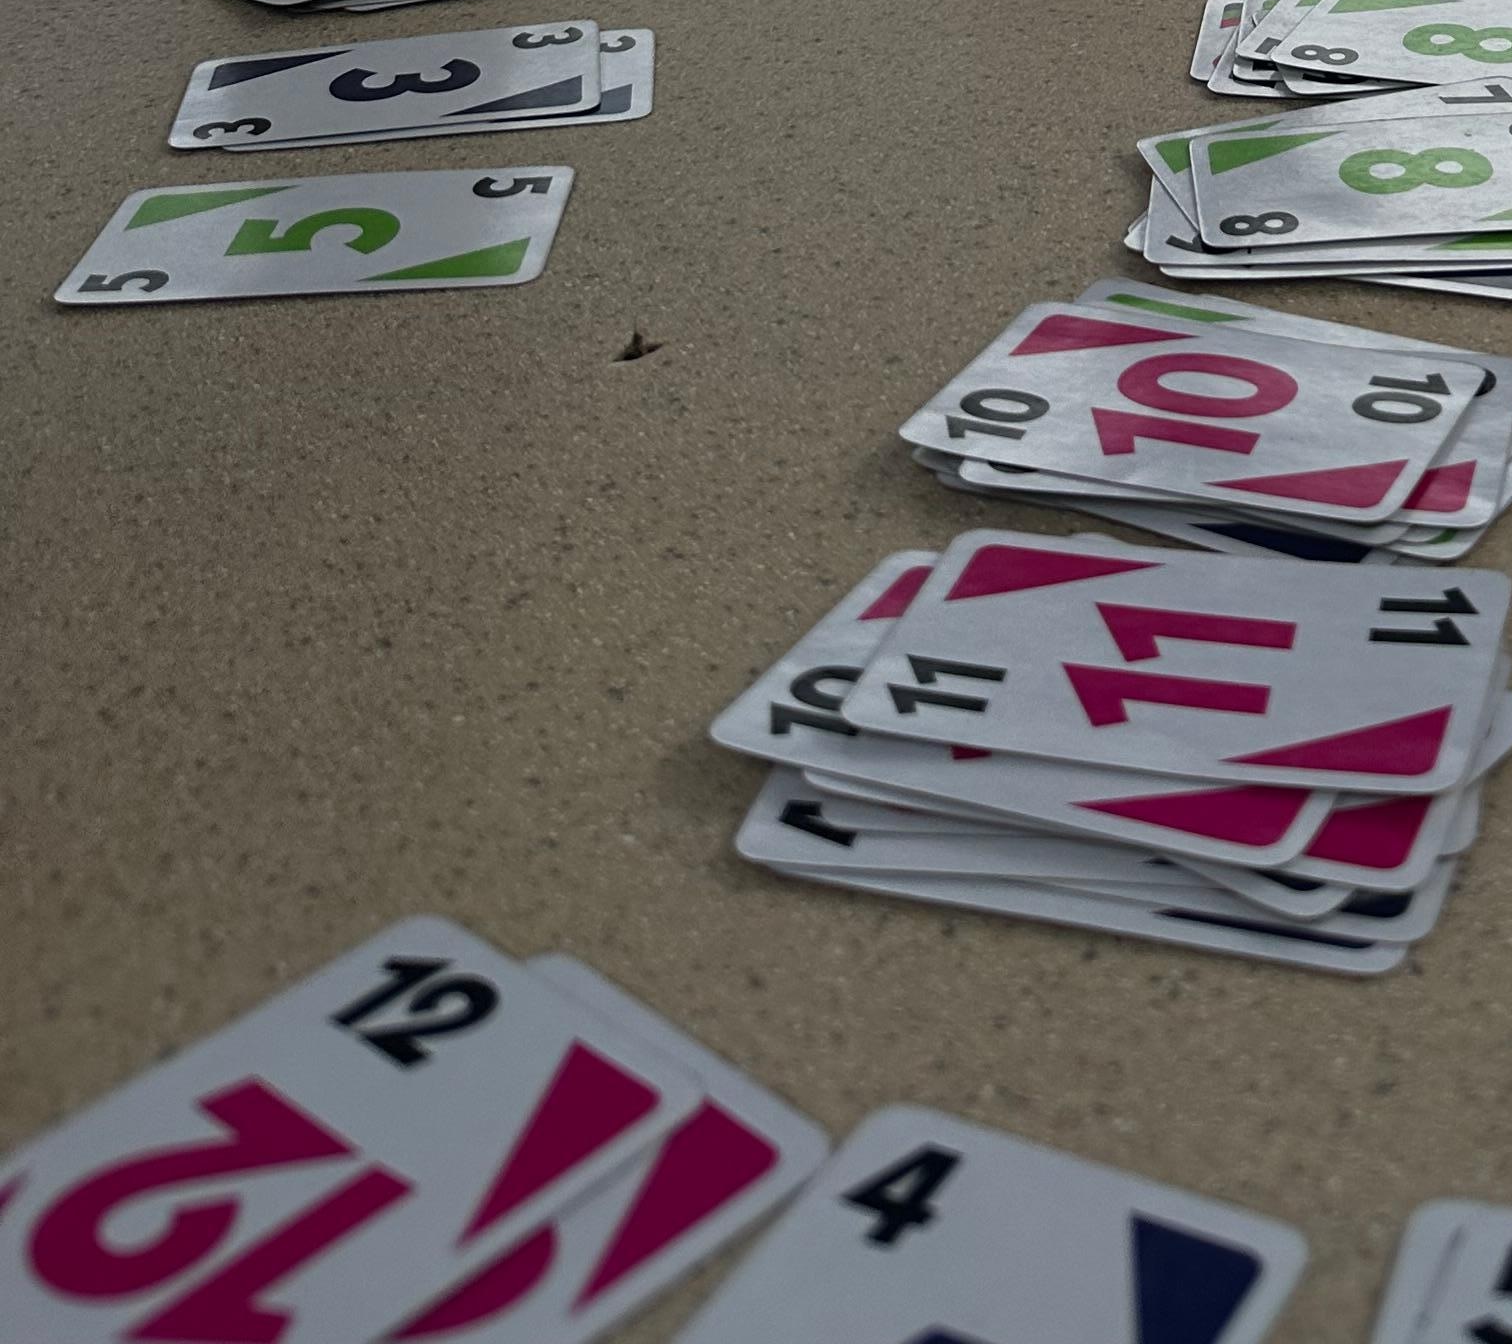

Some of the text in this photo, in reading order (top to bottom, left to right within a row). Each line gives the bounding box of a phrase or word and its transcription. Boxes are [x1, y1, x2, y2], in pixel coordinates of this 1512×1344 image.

[512, 26, 584, 49] 3
[1290, 44, 1360, 66] 8
[329, 58, 481, 102] 3
[192, 117, 272, 140] 3
[472, 175, 553, 199] 5
[1338, 147, 1494, 195] 8
[223, 206, 401, 256] 5
[1219, 211, 1300, 236] 8
[77, 269, 169, 293] 5
[944, 388, 1050, 441] 10
[1091, 352, 1299, 456] 10
[1351, 373, 1452, 424] 10
[1367, 586, 1480, 646] 11
[886, 653, 1009, 715] 11
[1061, 601, 1298, 729] 11
[327, 954, 502, 1072] 12
[23, 1073, 417, 1344] 12
[840, 1140, 965, 1246] 4
